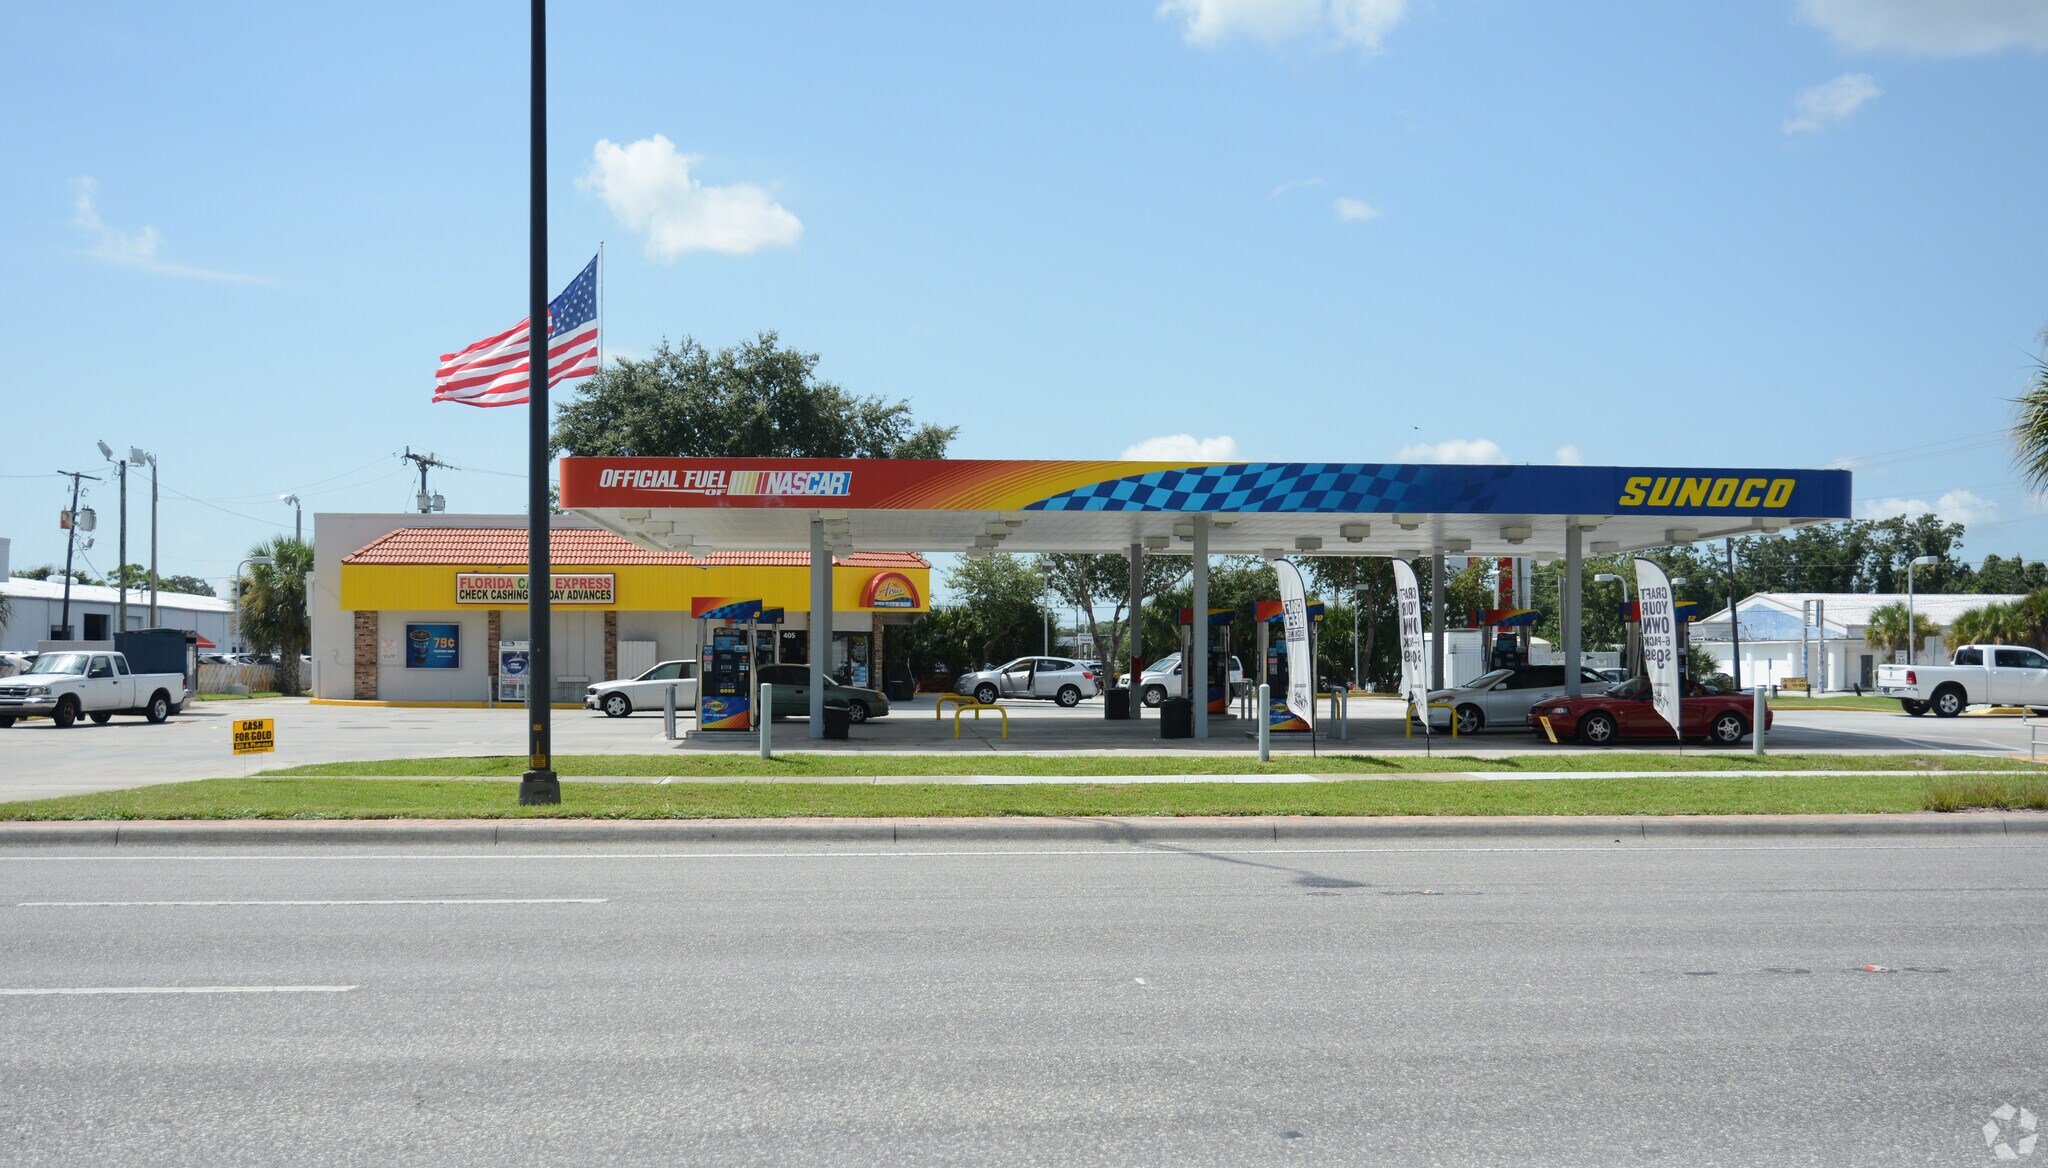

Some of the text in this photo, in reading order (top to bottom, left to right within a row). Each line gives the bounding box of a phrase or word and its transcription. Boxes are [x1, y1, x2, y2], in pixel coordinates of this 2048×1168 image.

[599, 468, 845, 495] OFFICIAL FUEL NASCAR
[704, 488, 727, 496] OF
[1618, 476, 1796, 508] SUNOCO
[459, 577, 514, 590] FLORIDA
[555, 577, 612, 590] EXPRESS
[459, 589, 489, 600] CHECK
[491, 589, 529, 600] CASHING
[567, 589, 612, 600] ADVANCES
[242, 720, 264, 731] CASH
[235, 730, 272, 742] FOR GOLD
